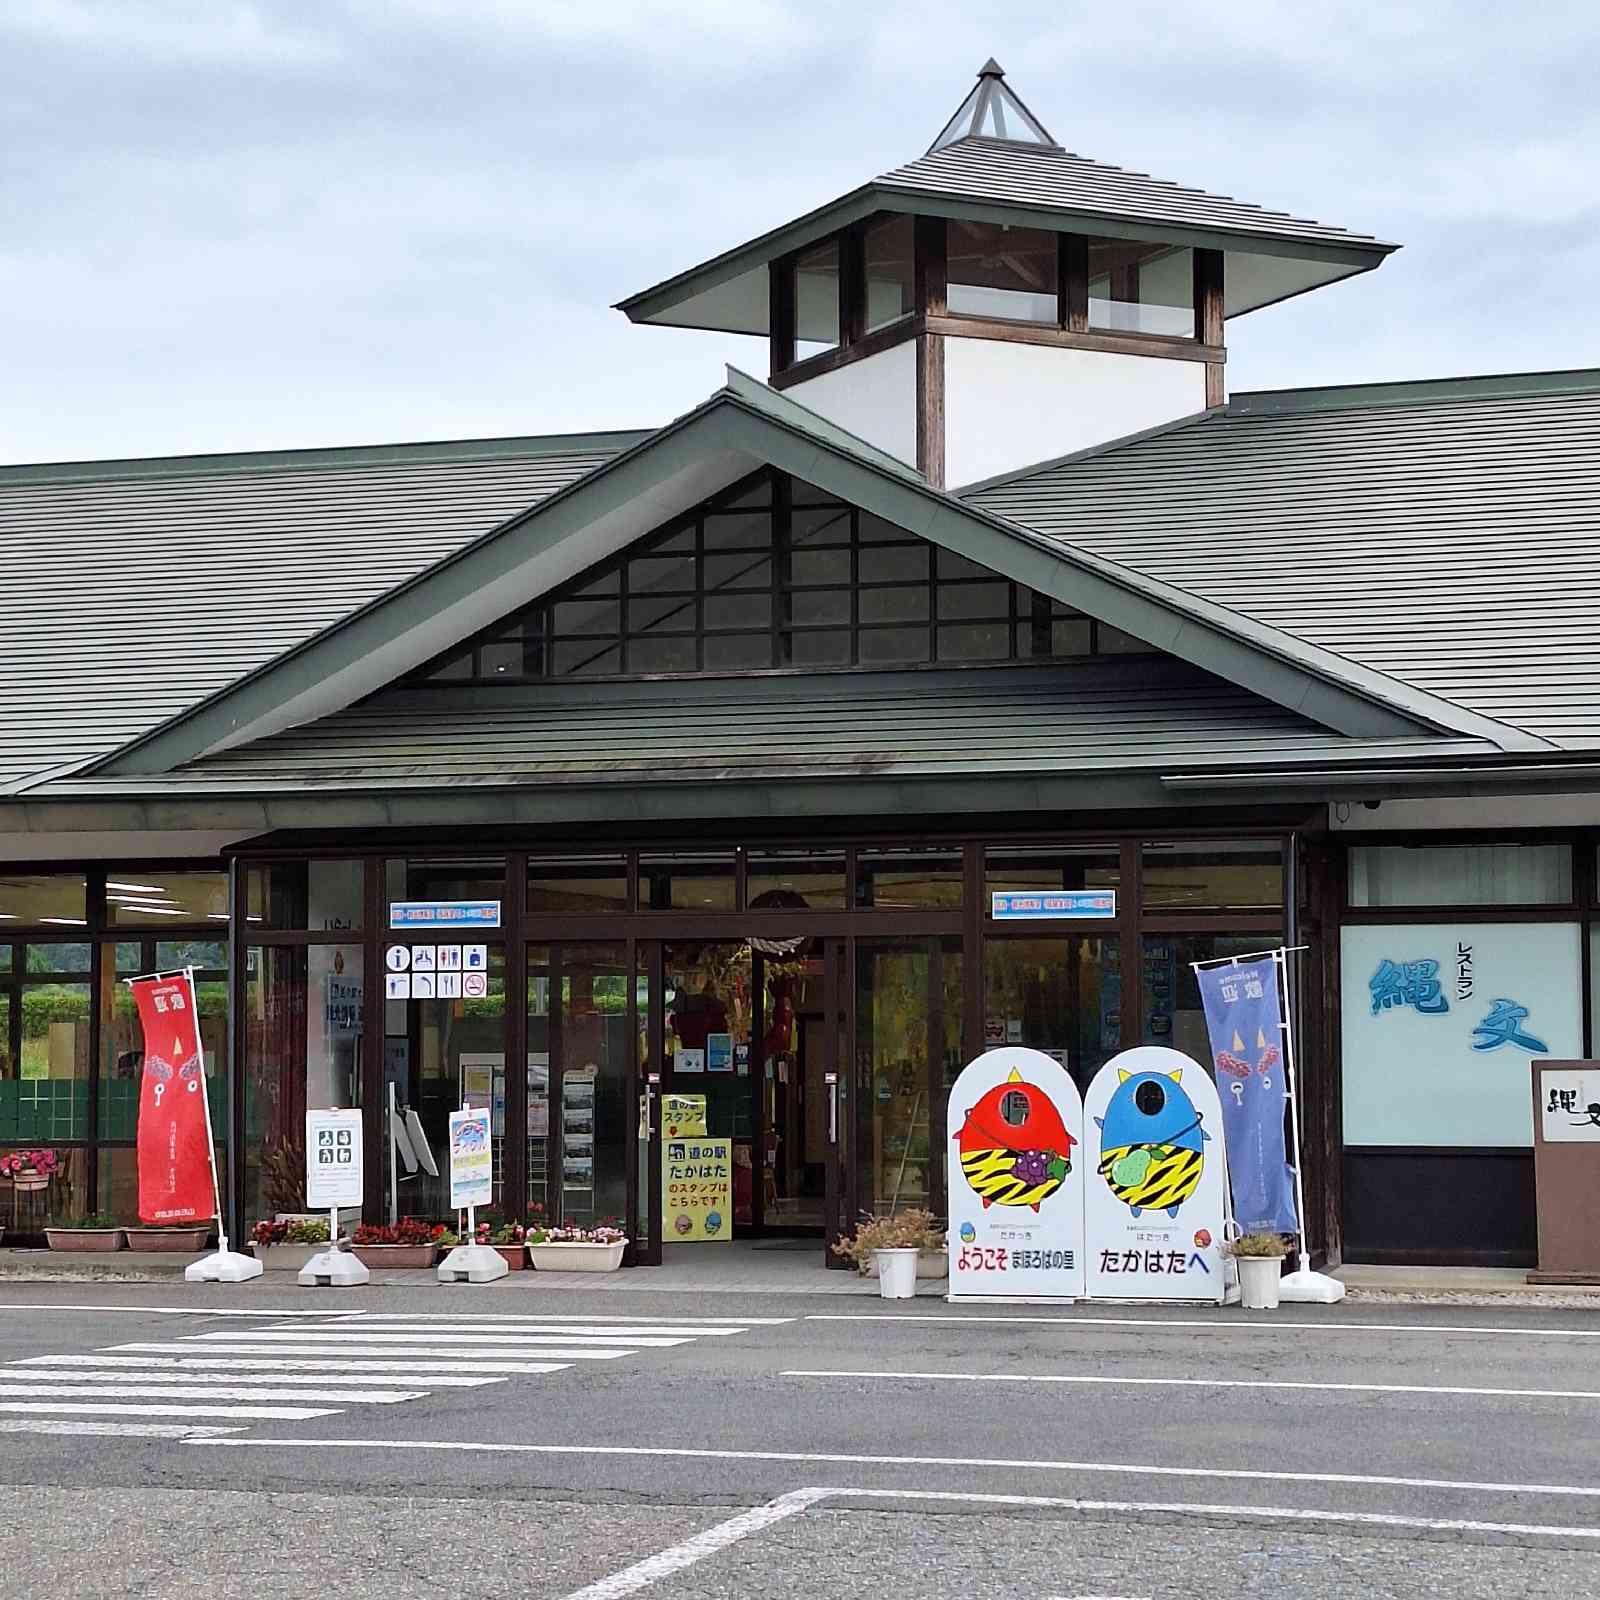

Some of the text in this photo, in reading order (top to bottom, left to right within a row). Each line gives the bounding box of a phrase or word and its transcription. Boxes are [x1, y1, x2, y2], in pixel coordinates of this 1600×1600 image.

[1457, 942, 1473, 1000] レストラン
[1369, 959, 1549, 1053] 縄文
[664, 1112, 704, 1122] スタンプ
[688, 1146, 727, 1160] 道の駅
[669, 1165, 728, 1179] たかはた
[669, 1183, 728, 1193] のスタンプは
[958, 1247, 1075, 1271] ようこそ まほろばの里
[1100, 1249, 1210, 1274] たかはたへ
